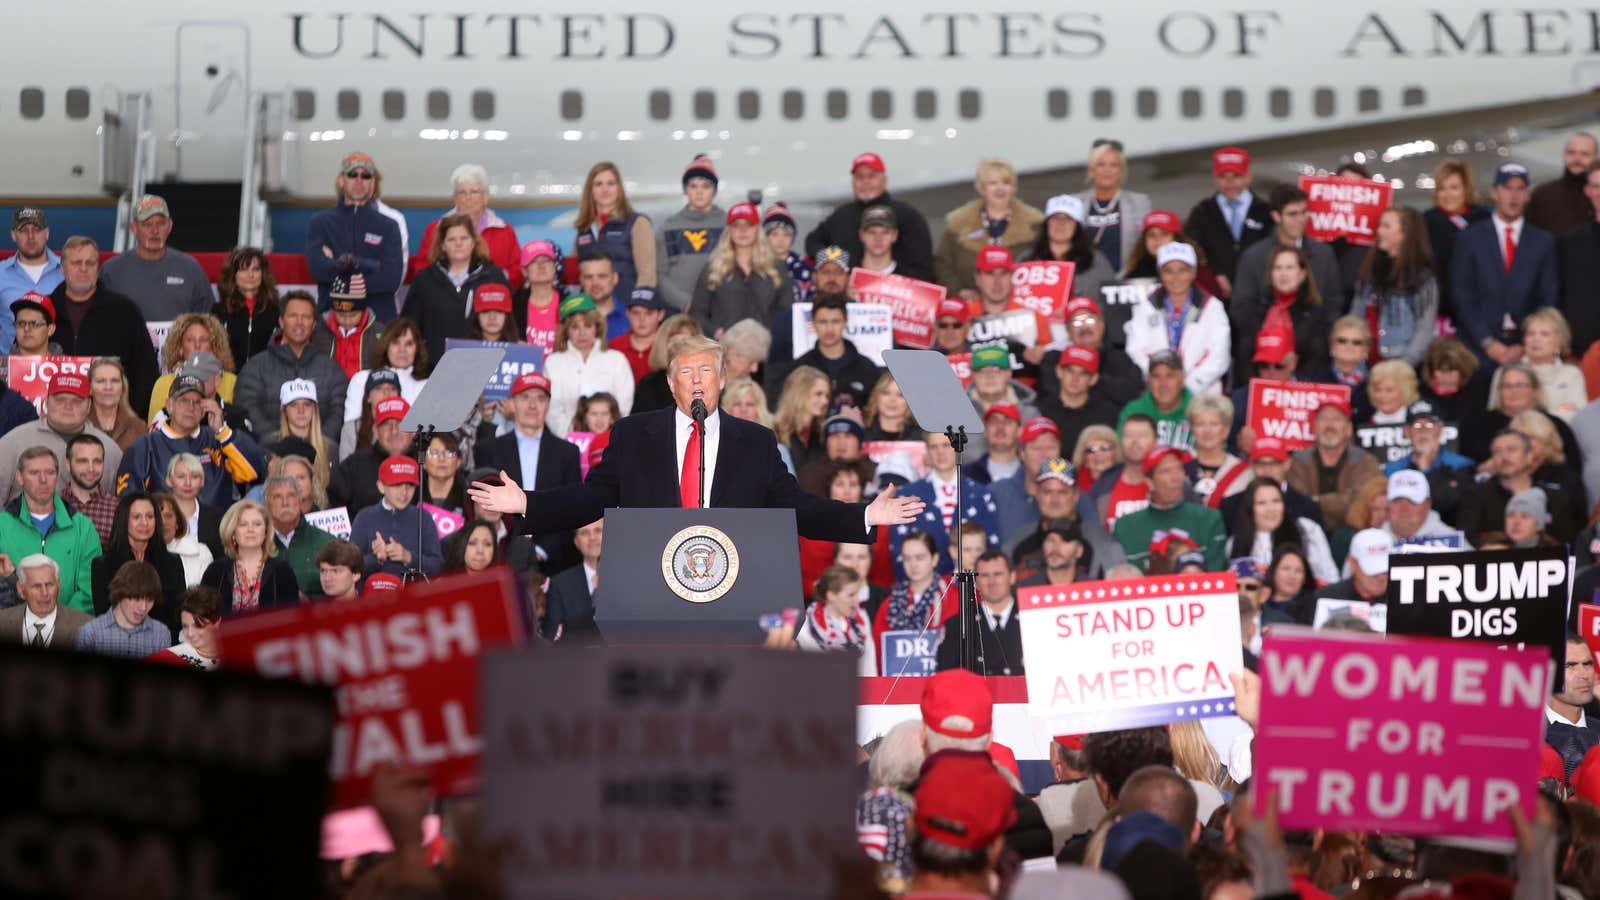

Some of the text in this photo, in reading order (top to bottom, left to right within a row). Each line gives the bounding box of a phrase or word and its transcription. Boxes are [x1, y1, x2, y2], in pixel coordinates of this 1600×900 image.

[290, 12, 675, 60] UNITED
[727, 12, 1107, 60] STATES
[1158, 9, 1282, 58] OF
[1310, 183, 1380, 206] FINISH
[1307, 211, 1374, 235] WALL
[1011, 265, 1060, 286] OBS
[290, 384, 310, 392] USA
[1262, 388, 1328, 410] FINIS
[1262, 418, 1316, 441] WAL
[1284, 408, 1309, 421] THE
[1357, 426, 1459, 448] TRUP
[1389, 559, 1566, 605] TRUMP
[1056, 603, 1205, 638] STAND UP
[1451, 607, 1518, 638] DIGS
[1112, 639, 1155, 660] FOR
[606, 658, 736, 710] BUY
[1050, 660, 1228, 708] AMERICA
[1264, 652, 1544, 709] WOMEN
[5, 662, 328, 770] RUMP
[1346, 718, 1445, 756] FOR
[602, 774, 736, 822] HIRE
[1268, 767, 1520, 823] TRUMP
